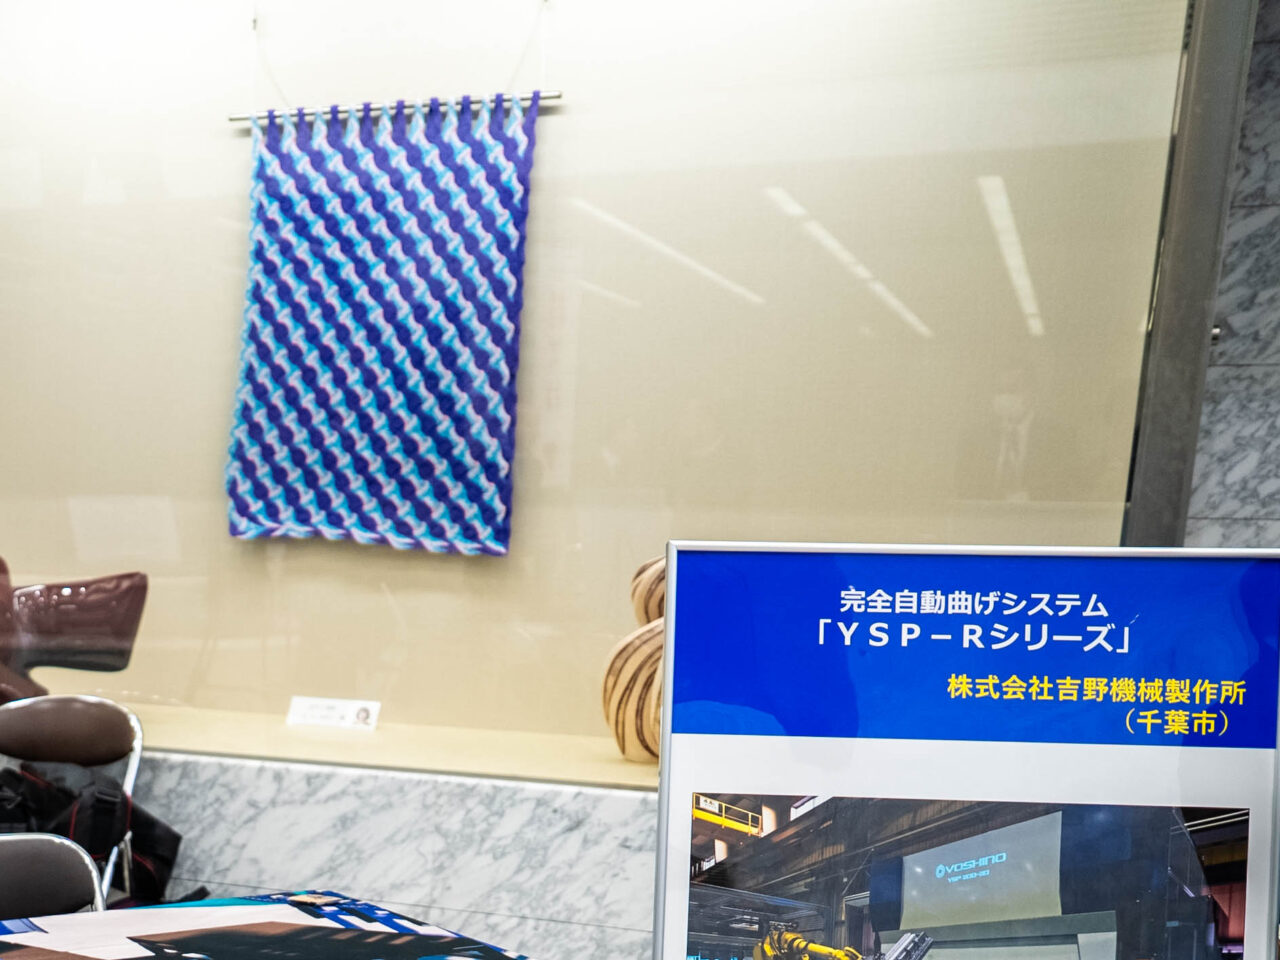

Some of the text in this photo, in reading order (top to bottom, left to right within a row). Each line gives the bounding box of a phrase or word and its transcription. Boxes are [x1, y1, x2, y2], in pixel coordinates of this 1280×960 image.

[840, 589, 1109, 618] 完全自動曲げシステム
[947, 673, 1247, 706] 株式会社吉野機械製作所
